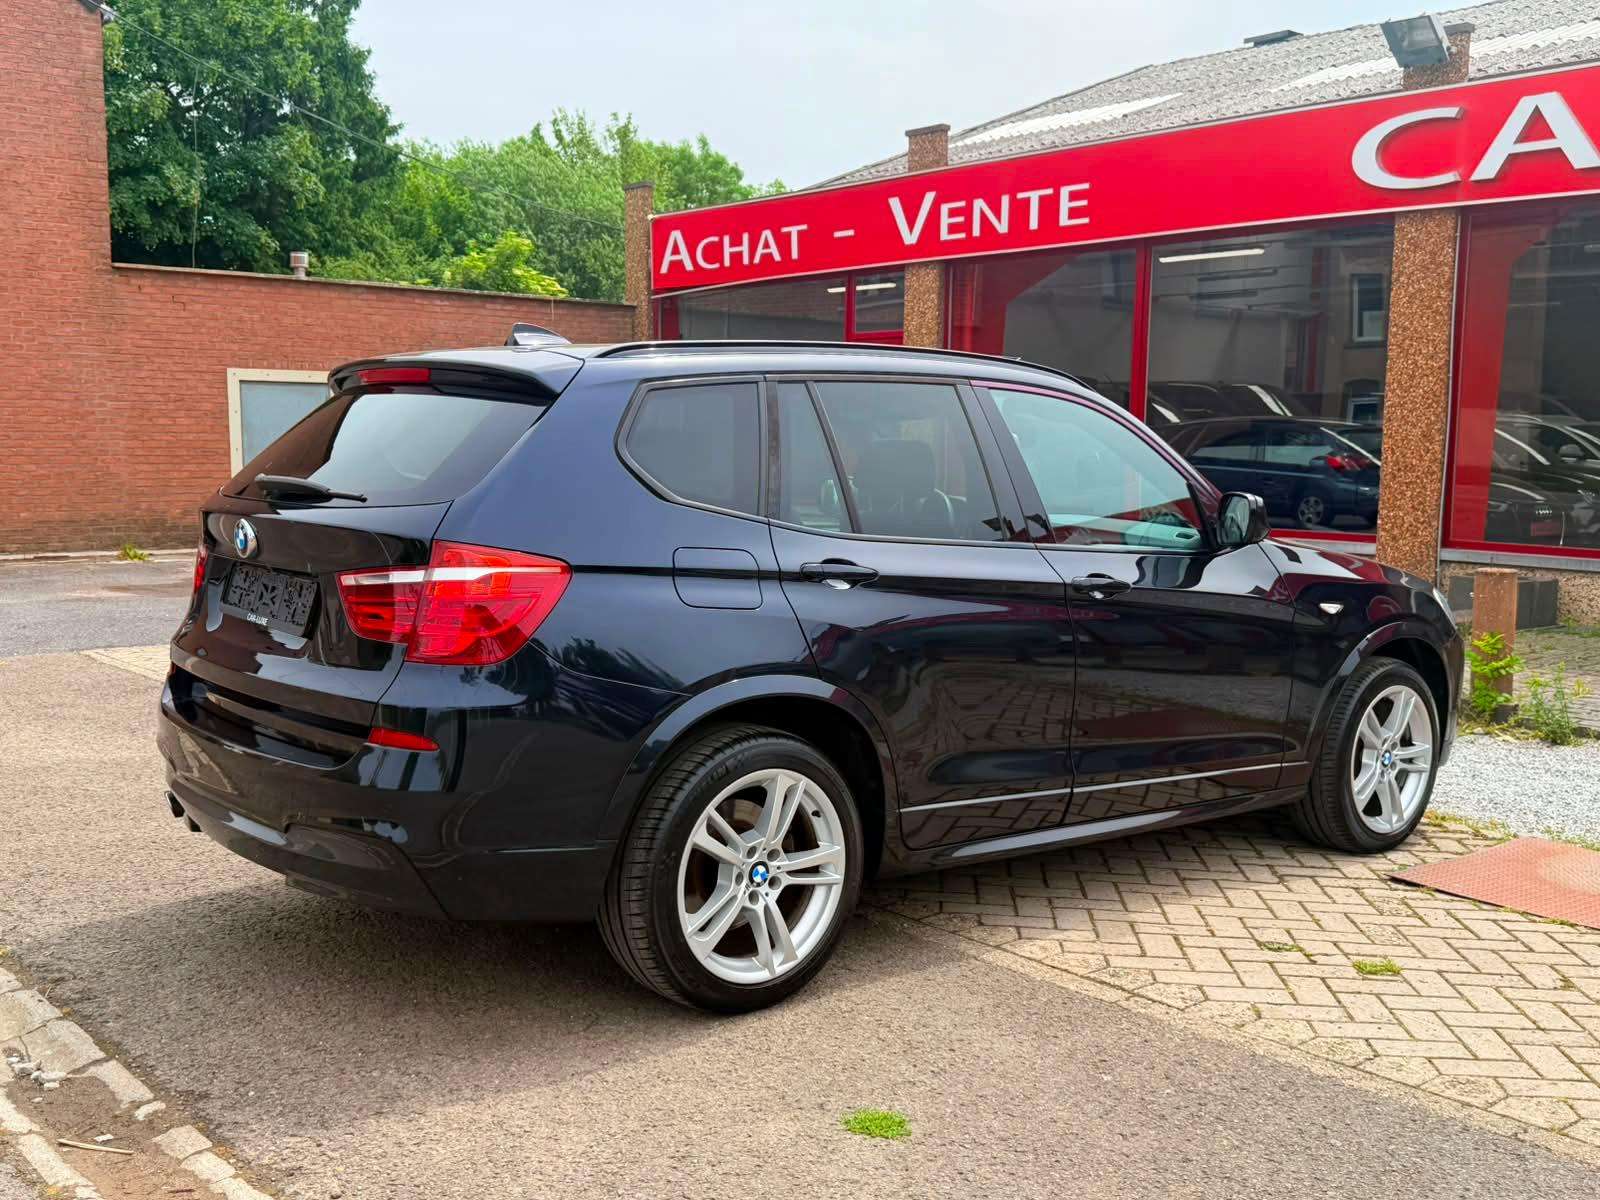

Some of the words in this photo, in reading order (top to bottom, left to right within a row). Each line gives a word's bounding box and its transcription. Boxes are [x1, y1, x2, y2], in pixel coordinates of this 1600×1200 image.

[1352, 91, 1600, 190] CA
[660, 224, 808, 274] ACHAT
[888, 182, 1091, 246] VENTE
